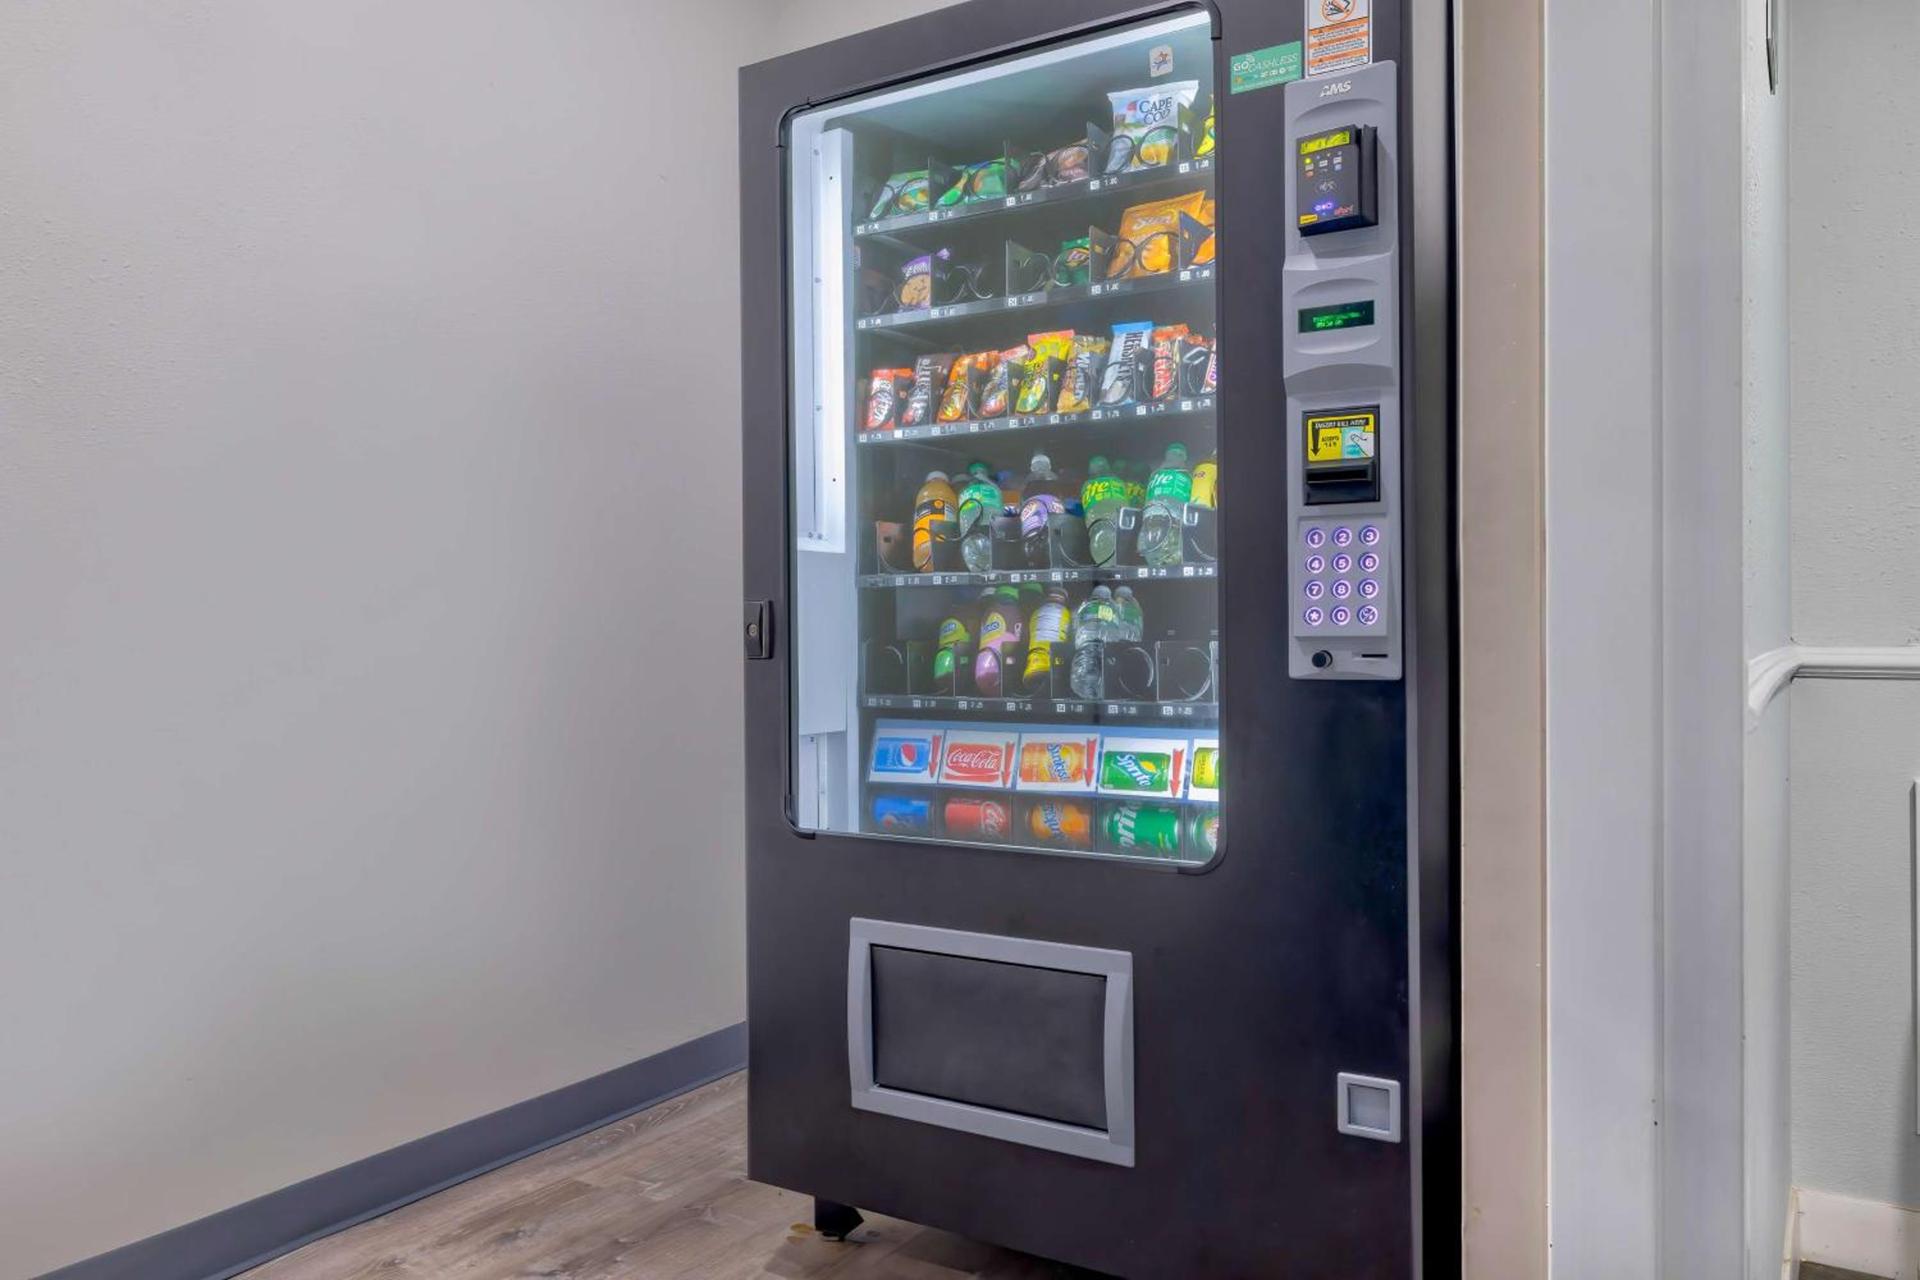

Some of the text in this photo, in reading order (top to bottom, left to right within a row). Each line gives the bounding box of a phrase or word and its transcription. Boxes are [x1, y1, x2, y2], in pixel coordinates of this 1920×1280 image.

[1139, 97, 1172, 114] CAPE
[1338, 533, 1347, 542] 2
[1366, 532, 1374, 540] 3
[1311, 558, 1373, 568] 4 5 6
[1311, 584, 1373, 594] 7 8 9
[1337, 611, 1345, 619] 0
[1116, 754, 1153, 786] Sprite
